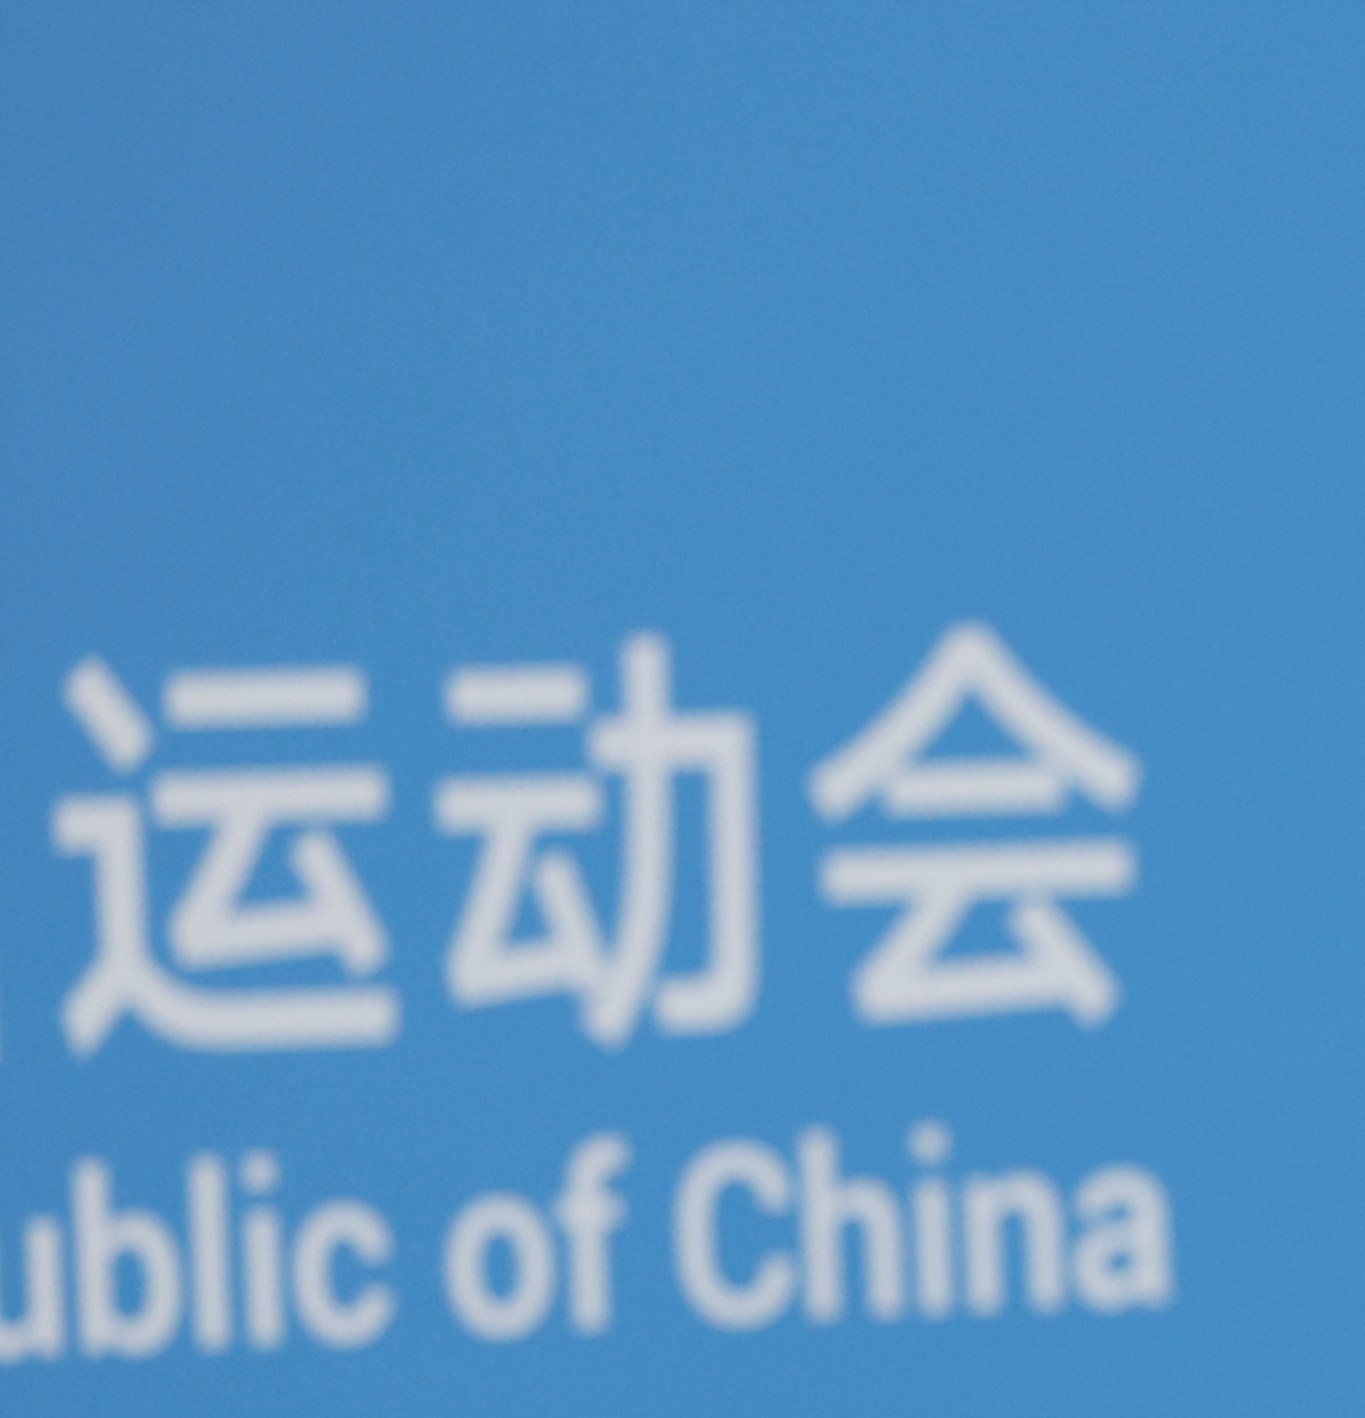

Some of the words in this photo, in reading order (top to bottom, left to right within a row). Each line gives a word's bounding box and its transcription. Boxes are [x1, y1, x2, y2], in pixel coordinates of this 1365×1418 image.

[53, 625, 1139, 1052] 运动会
[444, 1135, 629, 1340] of
[674, 1125, 1173, 1328] China
